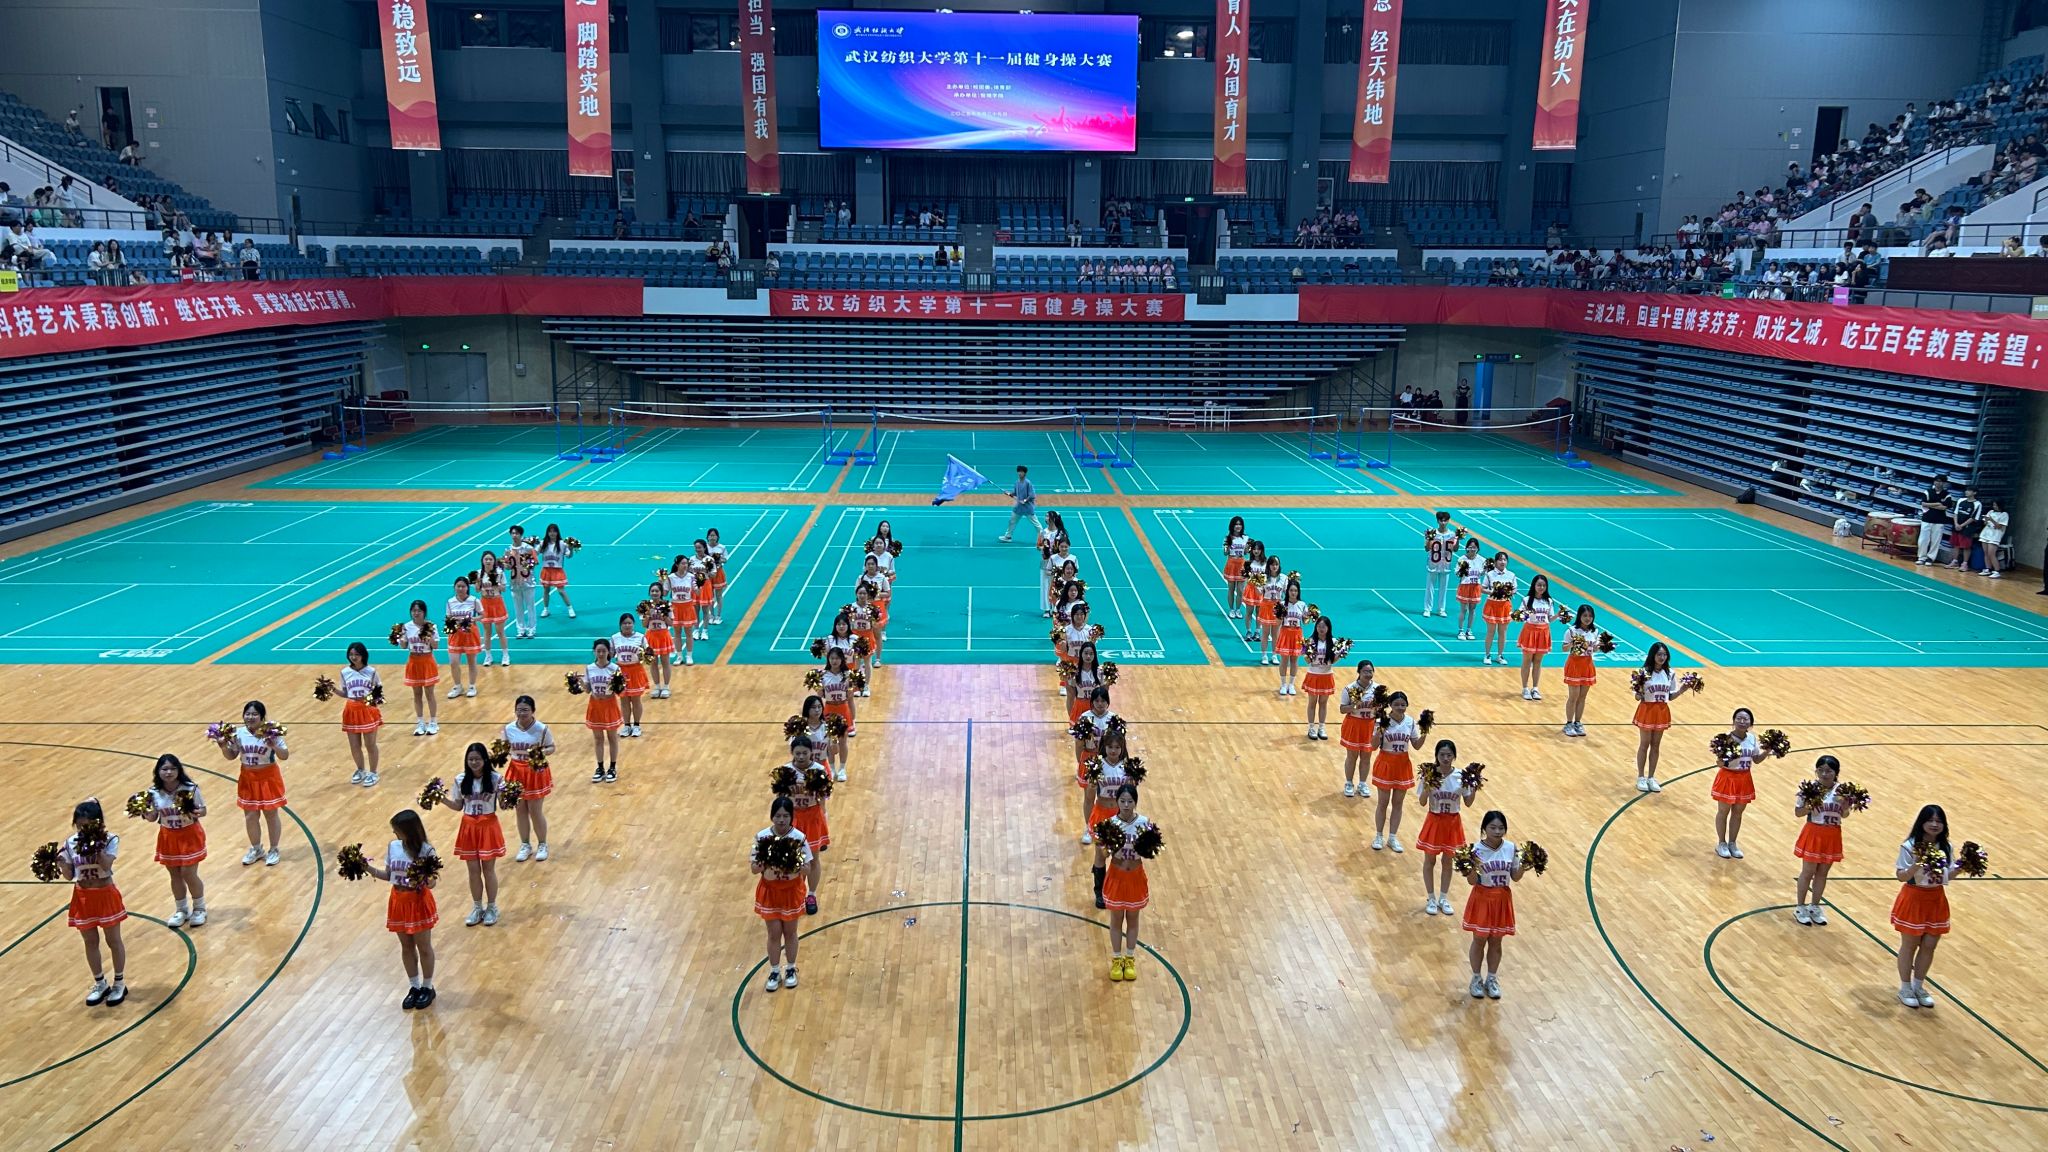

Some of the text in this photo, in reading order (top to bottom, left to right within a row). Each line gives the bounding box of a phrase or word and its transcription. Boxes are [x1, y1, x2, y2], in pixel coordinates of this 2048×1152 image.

[391, 0, 422, 83] 稳致远
[577, 22, 600, 117] 脚踏实地
[844, 50, 1114, 68] 武汉纺织大学第十一届健身操大赛
[1363, 29, 1389, 125] 经天纬地
[750, 52, 769, 139] 强国有我
[1223, 53, 1240, 142] 为国育才
[791, 294, 1164, 318] 武汉纺织大学第十一届健身操大赛
[1431, 541, 1454, 562] 85
[1491, 875, 1506, 887] 35
